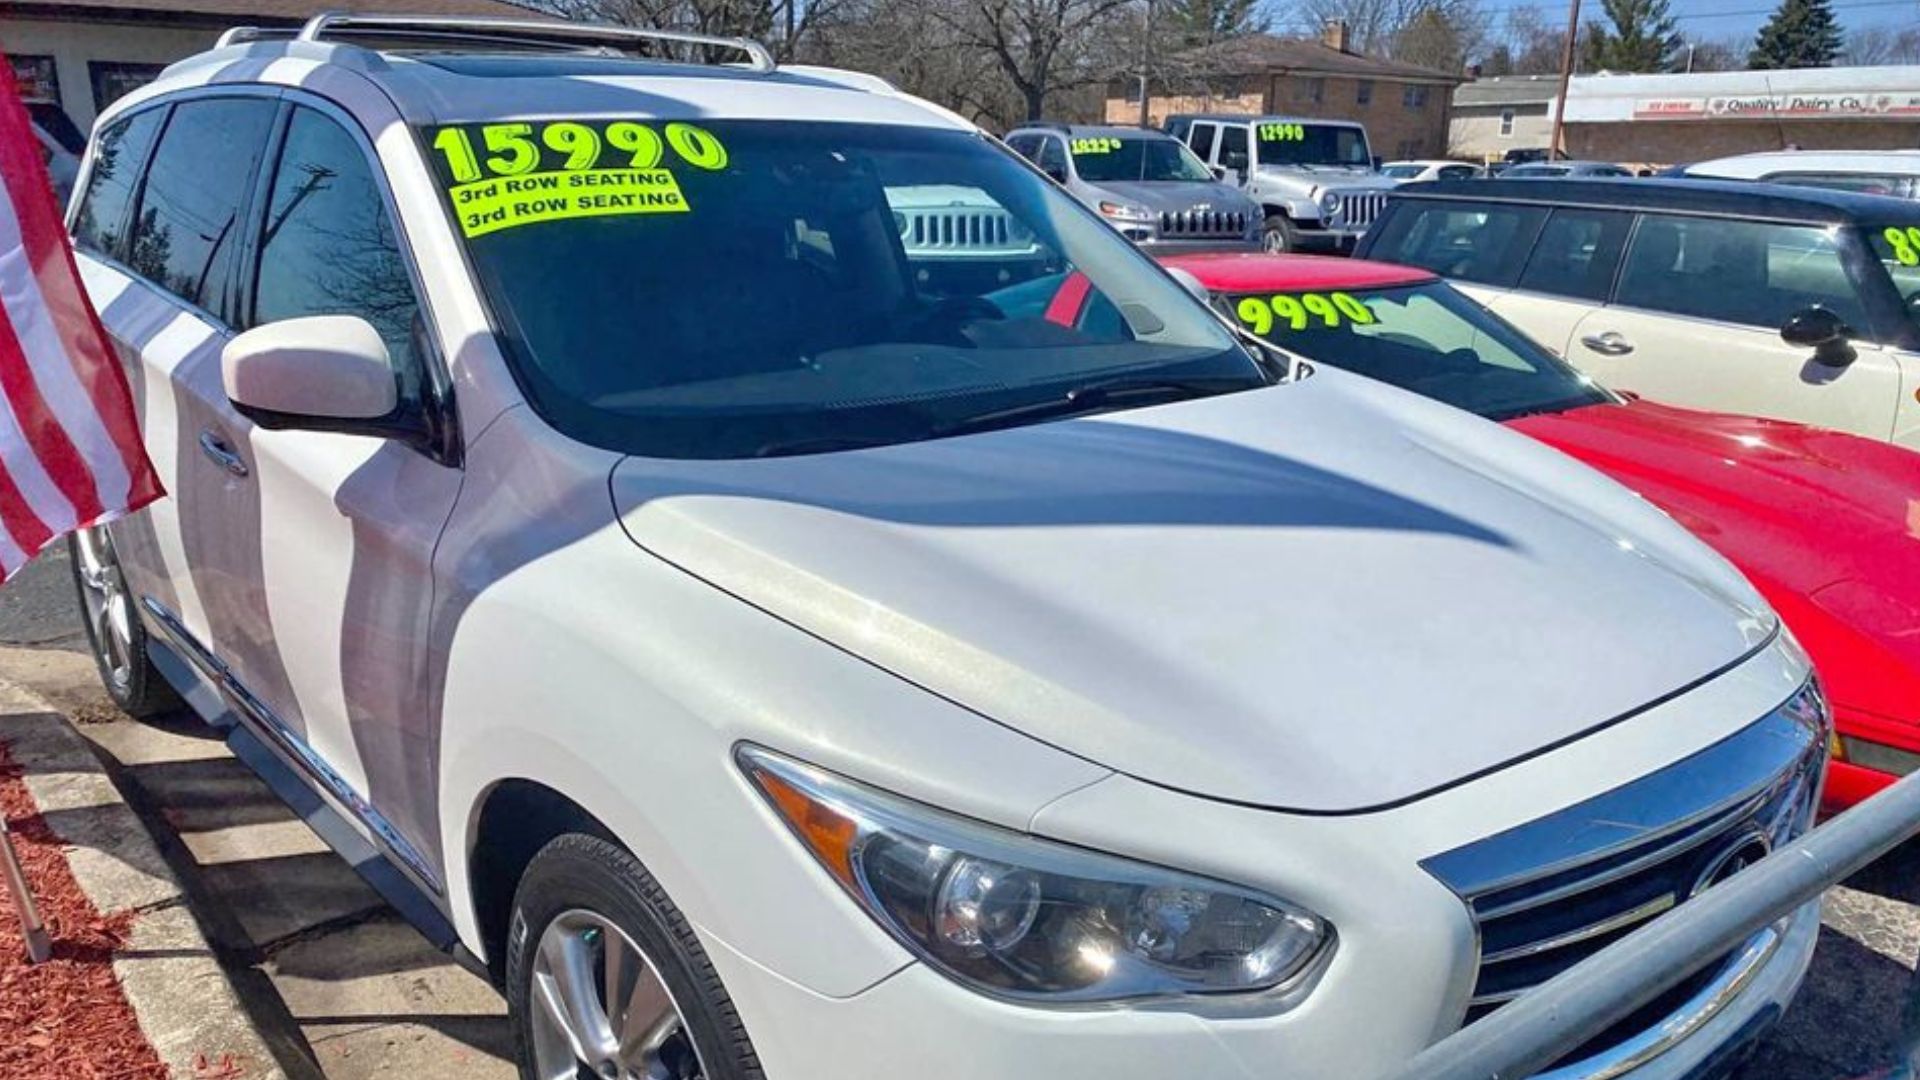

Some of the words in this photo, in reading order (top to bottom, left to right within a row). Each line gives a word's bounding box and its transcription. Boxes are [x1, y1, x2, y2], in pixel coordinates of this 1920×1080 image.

[1728, 99, 1779, 112] Quality
[1790, 97, 1833, 112] Dairy
[1260, 125, 1304, 142] 12990
[434, 122, 728, 183] 15990
[459, 181, 497, 204] 3rd
[506, 177, 558, 195] ROW
[569, 173, 671, 188] SEATING
[467, 207, 506, 228] 3rd
[515, 197, 568, 217] ROW
[578, 192, 680, 209] SEATING
[1238, 291, 1374, 336] 9990
